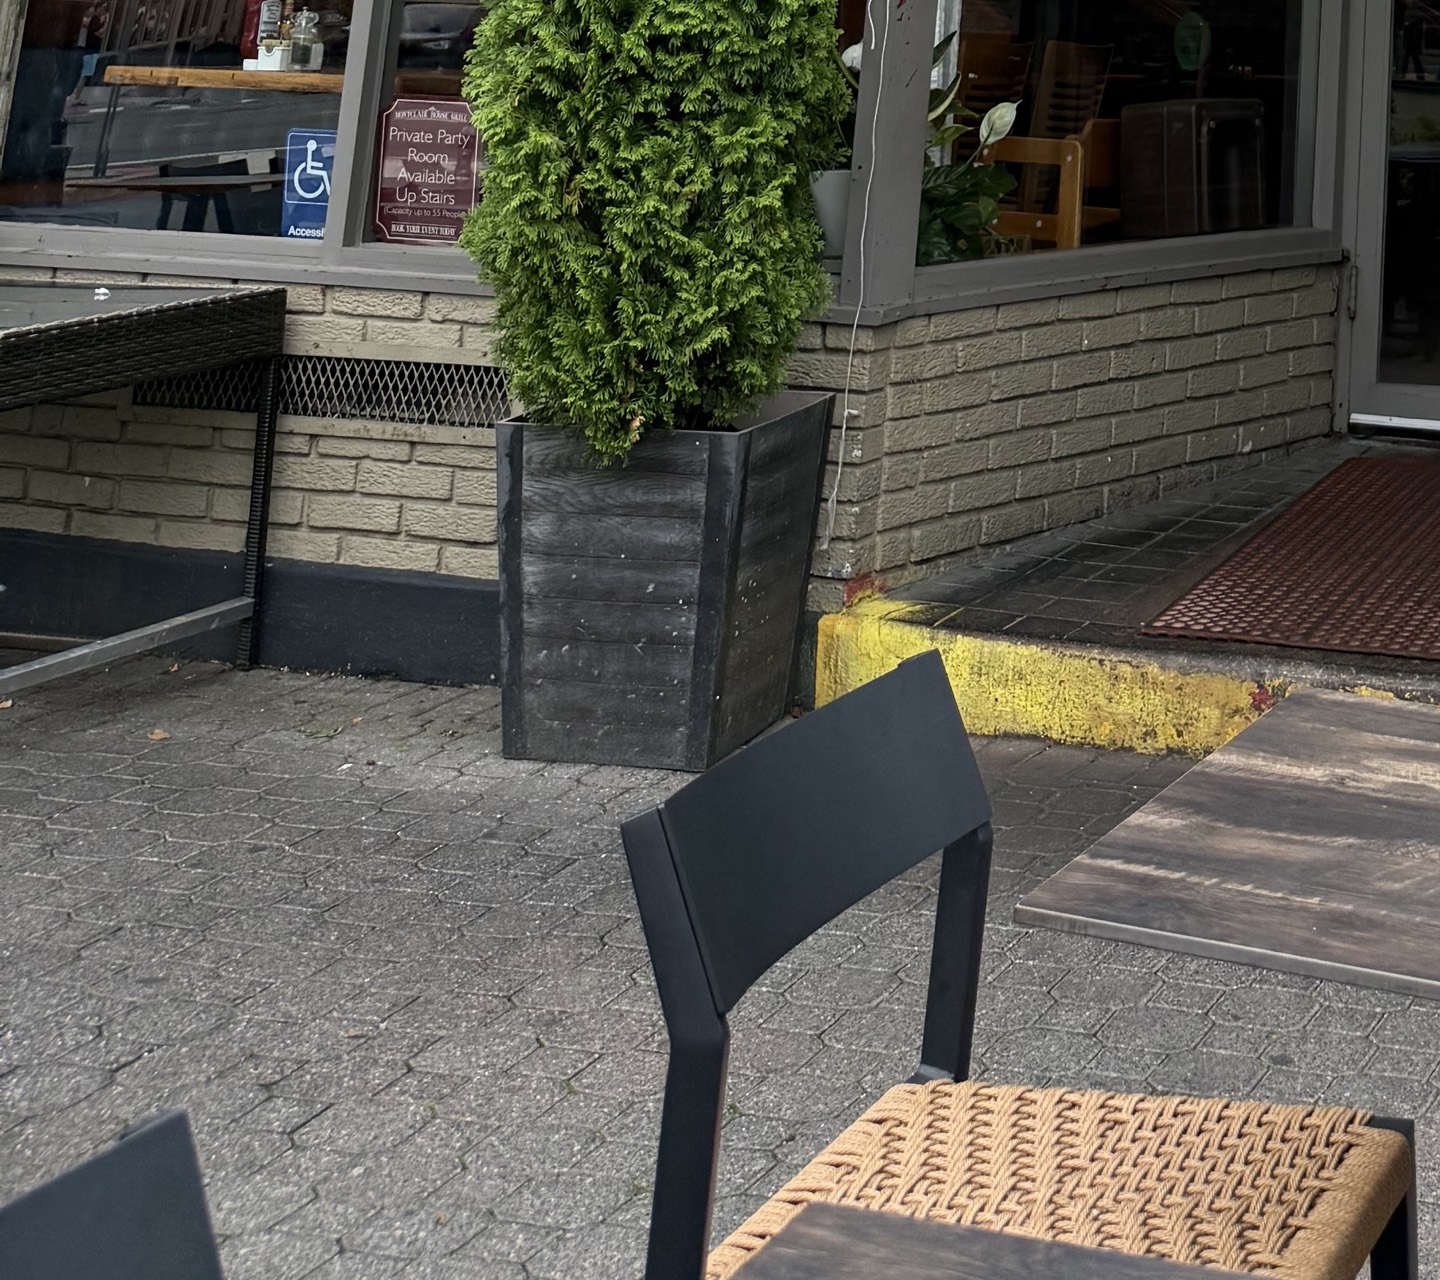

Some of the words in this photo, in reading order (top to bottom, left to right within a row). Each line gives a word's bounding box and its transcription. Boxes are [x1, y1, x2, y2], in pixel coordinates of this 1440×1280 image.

[389, 127, 433, 143] Private
[437, 129, 471, 149] Party
[407, 148, 449, 164] Room
[397, 167, 456, 185] Available
[396, 187, 417, 206] Up
[420, 188, 456, 205] Stairs
[414, 209, 423, 218] up
[424, 208, 431, 216] to
[432, 208, 441, 216] 55
